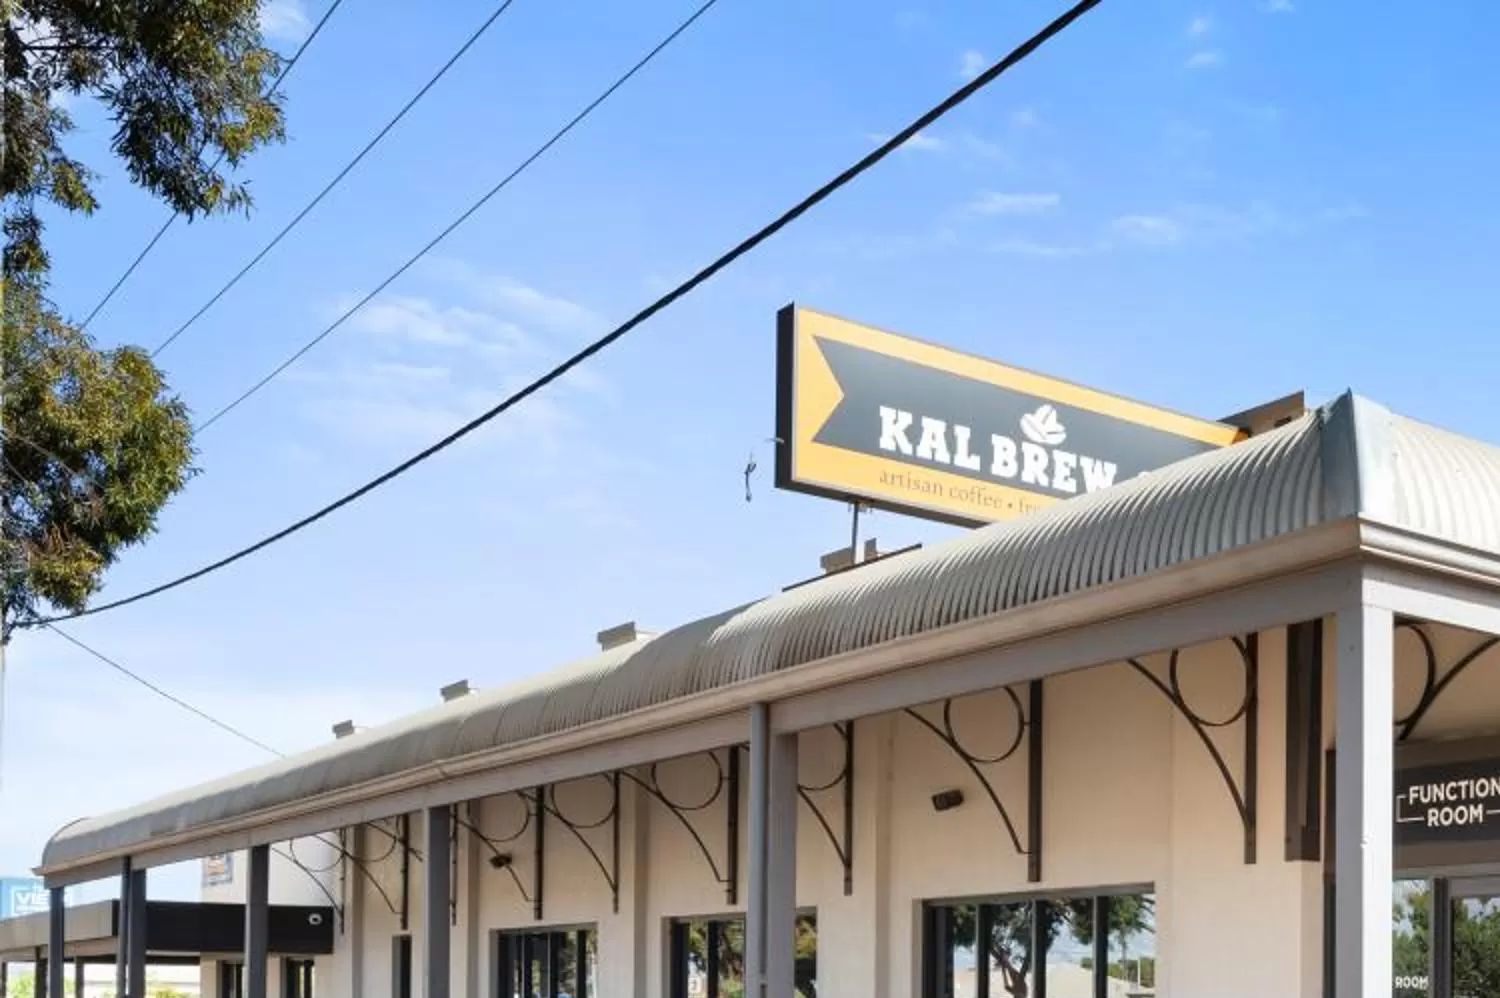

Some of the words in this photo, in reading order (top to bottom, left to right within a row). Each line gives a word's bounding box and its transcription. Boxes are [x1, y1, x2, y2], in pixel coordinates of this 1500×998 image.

[879, 405, 981, 471] KAL
[879, 469, 943, 497] artisan
[949, 484, 1001, 509] coffee
[1427, 803, 1484, 827] ROOM
[1395, 975, 1429, 990] ROOM
